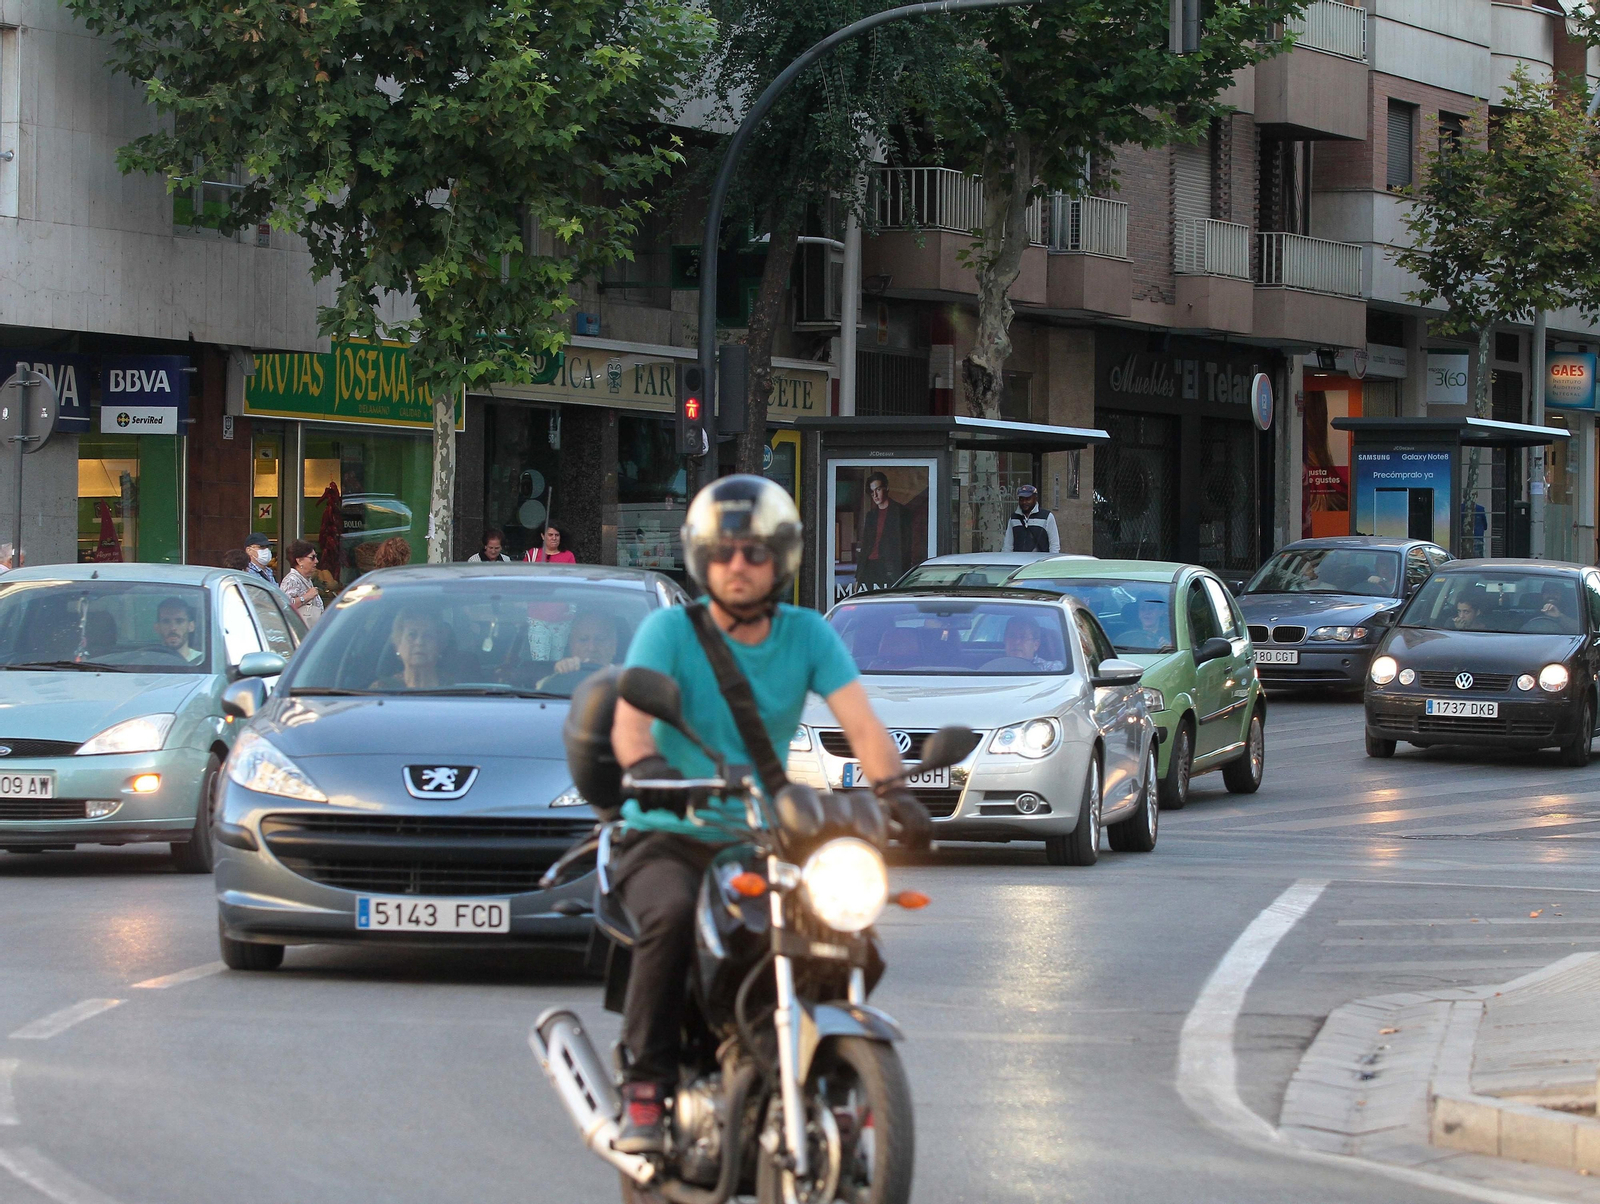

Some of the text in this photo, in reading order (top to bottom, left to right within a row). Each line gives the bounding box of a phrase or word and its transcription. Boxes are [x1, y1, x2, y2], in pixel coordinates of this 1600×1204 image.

[1110, 354, 1175, 398] Muebles
[1550, 364, 1584, 377] GAES
[109, 369, 171, 393] BBVA
[131, 415, 164, 425] ServiRed
[1401, 453, 1449, 462] Galaxy Note8
[1315, 476, 1341, 486] gustes
[1373, 470, 1434, 480] Precómpralo ya
[1275, 651, 1295, 662] CGT
[1436, 702, 1495, 716] 1737 DKB
[28, 777, 50, 795] AW
[375, 902, 438, 926] 5143
[455, 904, 503, 928] FCD
